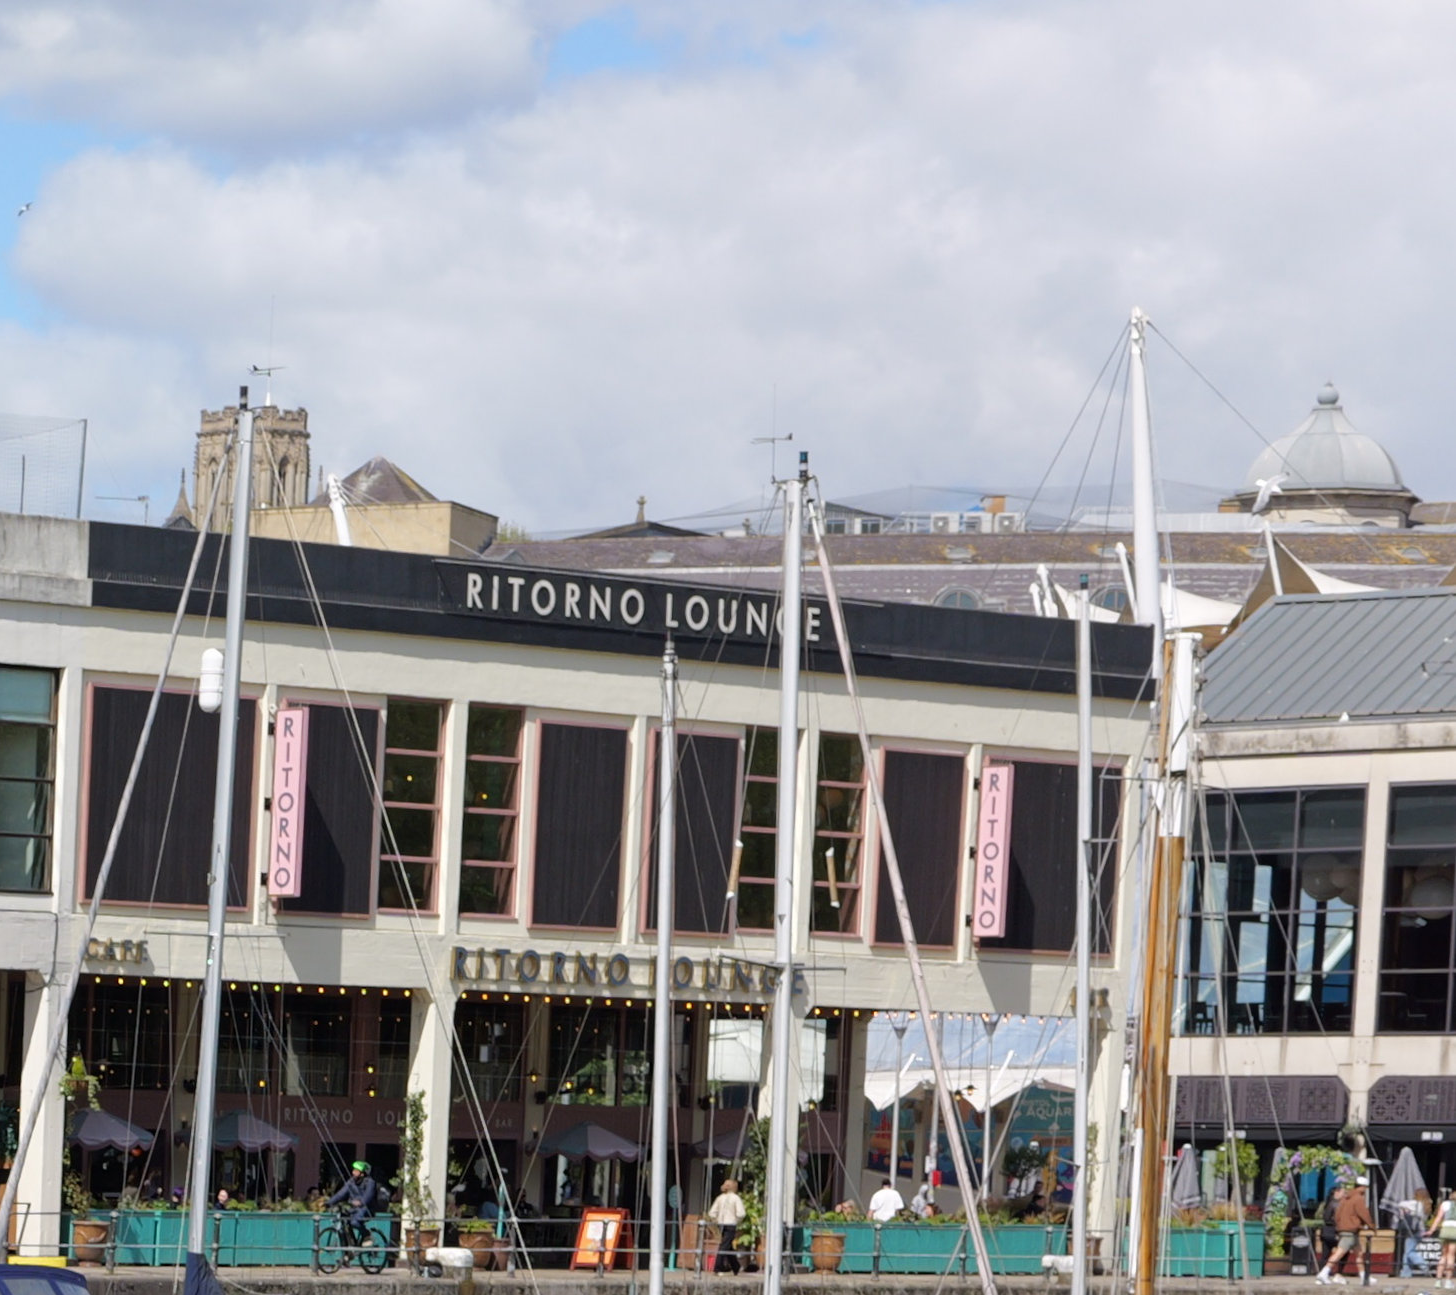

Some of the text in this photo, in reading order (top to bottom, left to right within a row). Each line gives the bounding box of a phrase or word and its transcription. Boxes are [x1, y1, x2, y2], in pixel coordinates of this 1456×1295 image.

[466, 571, 645, 625] RITORNO
[274, 717, 294, 888] RITORNO
[979, 773, 1000, 929] RITORNO
[450, 946, 630, 987] RITORNO
[284, 1106, 354, 1124] RITORNO
[1026, 1106, 1074, 1120] AQUAR
